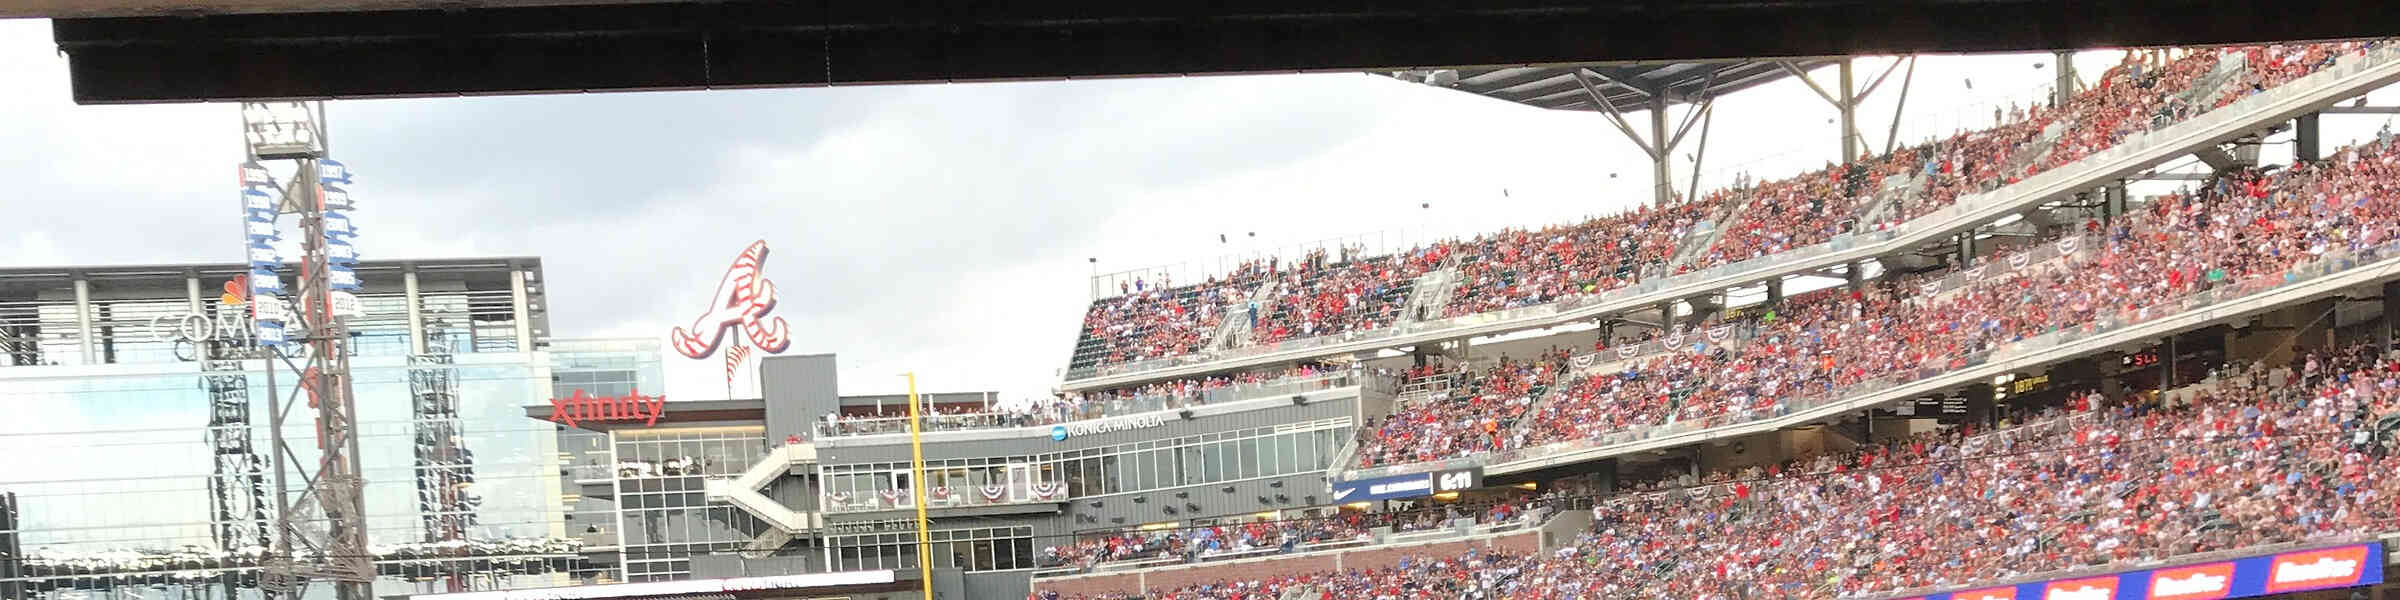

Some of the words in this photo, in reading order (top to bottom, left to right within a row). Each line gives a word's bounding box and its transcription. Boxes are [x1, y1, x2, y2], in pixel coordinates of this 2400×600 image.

[550, 387, 666, 429] xfinity
[1068, 422, 1111, 438] KONICA
[1113, 414, 1165, 432] MINOLTA
[1440, 471, 1472, 491] 6:11
